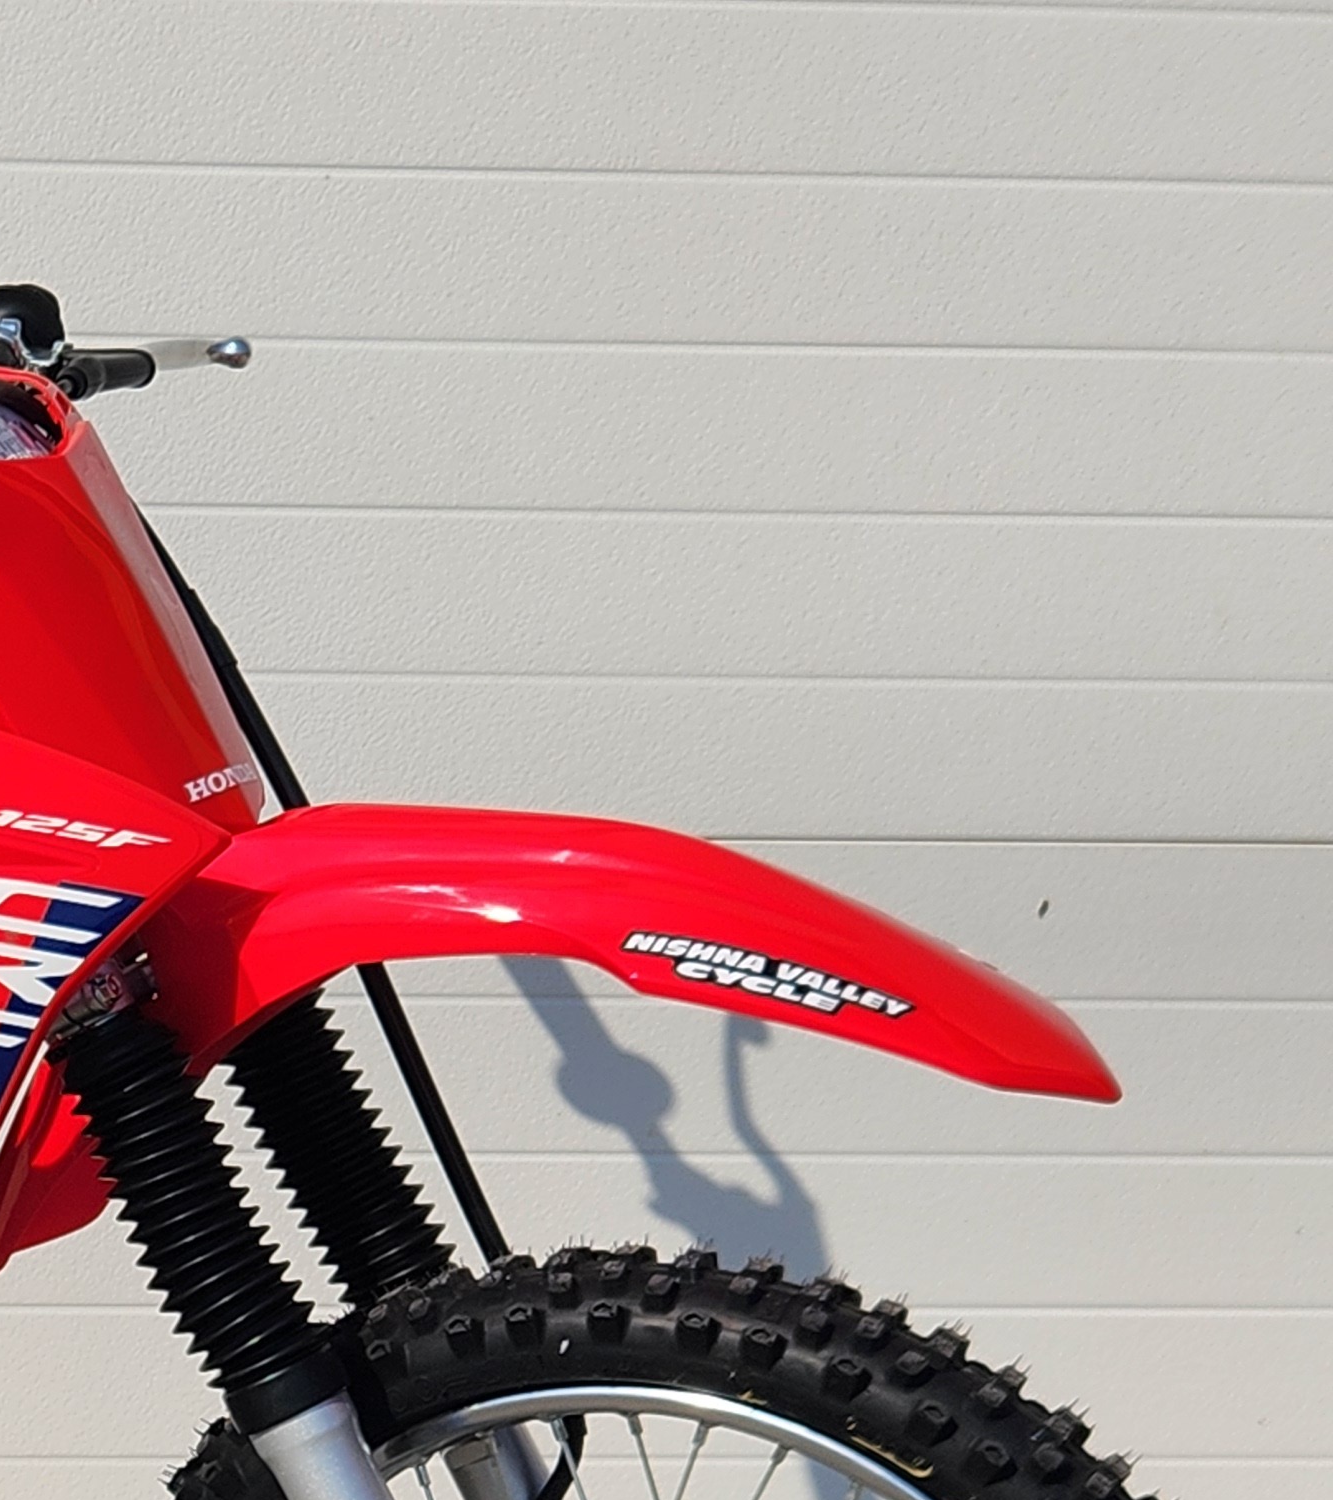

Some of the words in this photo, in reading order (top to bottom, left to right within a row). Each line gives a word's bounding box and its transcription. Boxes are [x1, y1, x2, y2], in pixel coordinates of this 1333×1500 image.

[182, 762, 258, 804] HONDA
[624, 931, 767, 974] NISHNA
[773, 961, 913, 1017] VALLEY
[674, 961, 841, 1013] CYCLE
